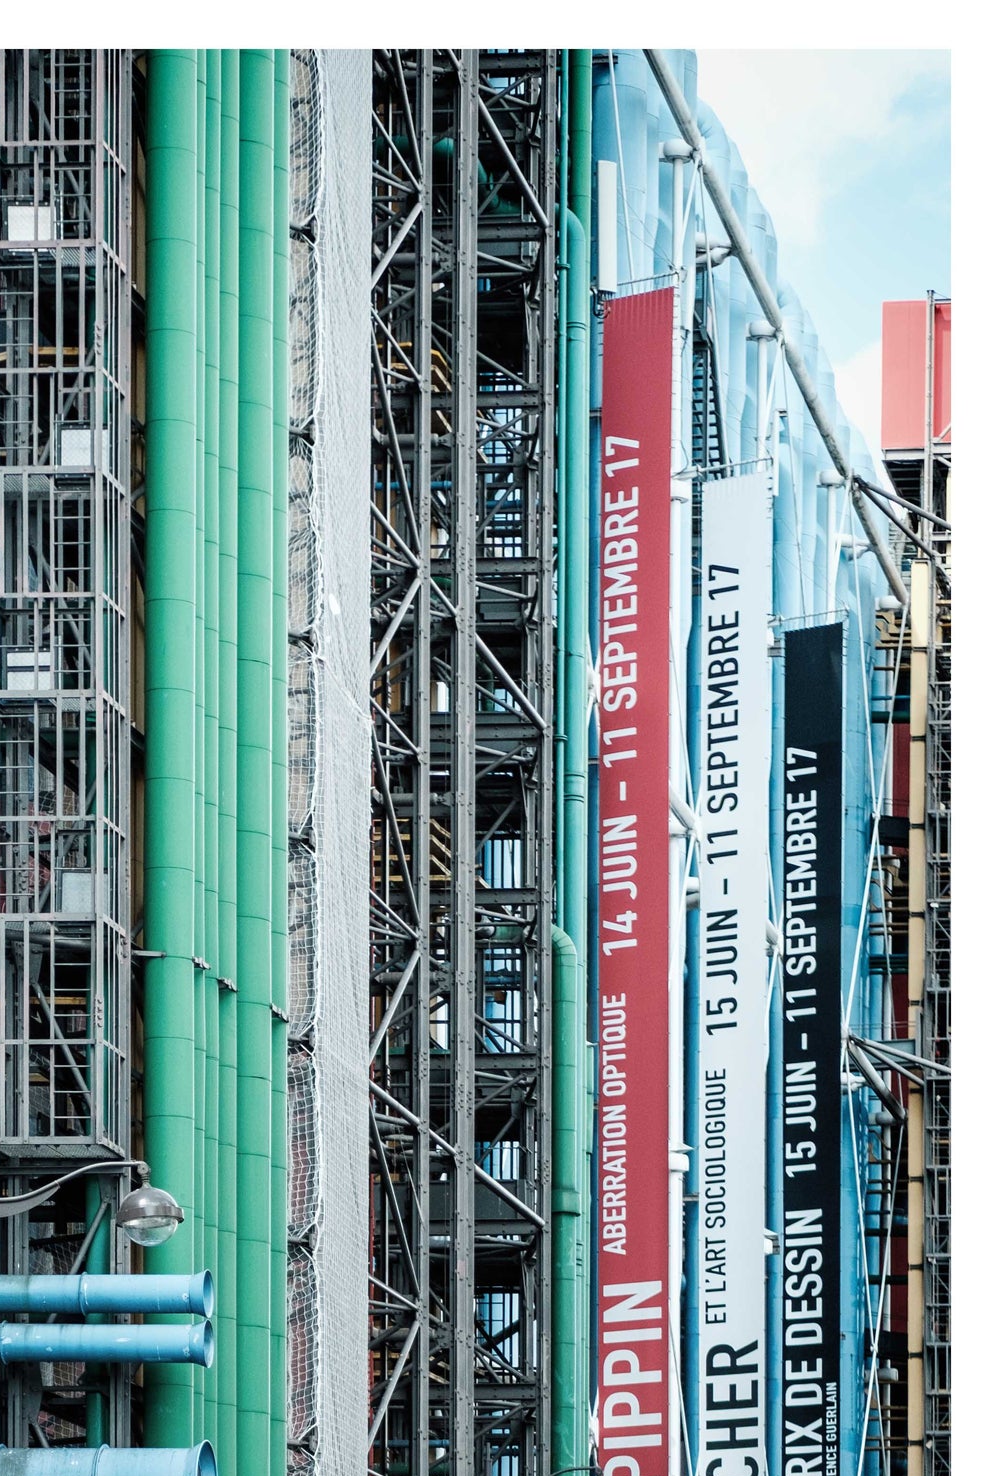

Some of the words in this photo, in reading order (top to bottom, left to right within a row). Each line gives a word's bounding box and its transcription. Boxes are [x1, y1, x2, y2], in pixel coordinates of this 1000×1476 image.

[605, 435, 640, 478] 17
[603, 486, 639, 713] SEPTEMBRE
[707, 563, 740, 601] 17
[706, 610, 739, 814] SEPTEMBRE
[602, 727, 638, 768] 11
[786, 746, 818, 782] 17
[602, 814, 638, 900] JUIN
[707, 828, 738, 865] 11
[785, 789, 818, 977] SEPTEMBRE
[602, 910, 638, 957] 14
[706, 908, 738, 985] JUIN
[706, 996, 738, 1036] 15
[785, 988, 817, 1023] 11
[602, 993, 626, 1097] OPTIQUE
[785, 1060, 817, 1133] JUIN
[704, 1067, 726, 1229] SOCIOLOGIQUE
[785, 1139, 817, 1178] 15
[602, 1104, 626, 1255] ABERRATION
[704, 1237, 726, 1293] L'ART
[784, 1207, 823, 1347] DESSIN
[705, 1301, 726, 1324] ET
[784, 1357, 823, 1407] DE
[825, 1381, 838, 1442] GUERLAIN
